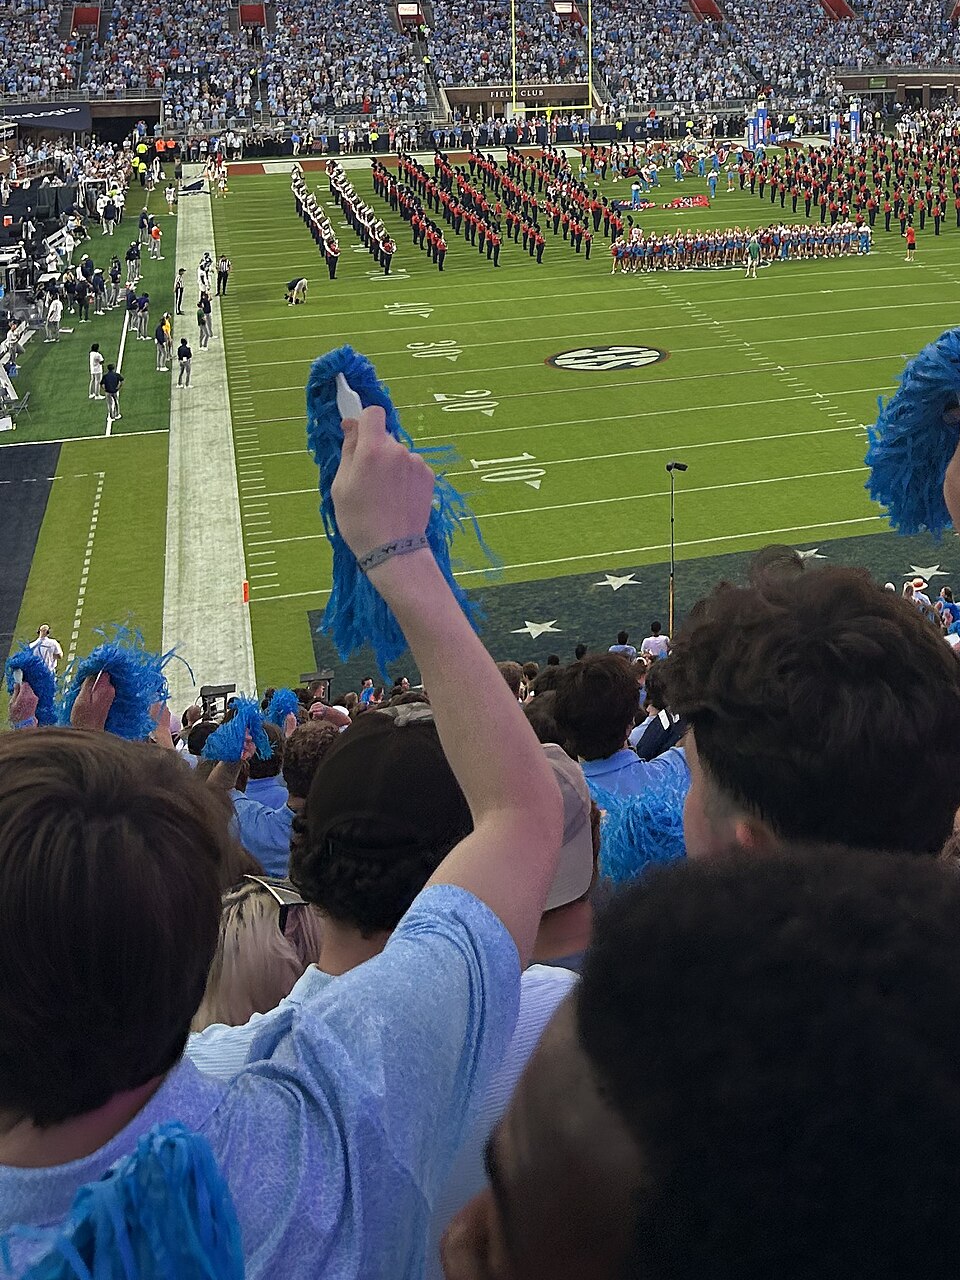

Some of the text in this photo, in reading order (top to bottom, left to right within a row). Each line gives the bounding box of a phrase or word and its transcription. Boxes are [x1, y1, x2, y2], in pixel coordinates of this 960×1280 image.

[520, 89, 544, 97] CLUB
[406, 339, 463, 358] 30
[433, 389, 499, 412] 20
[470, 452, 547, 483] 10
